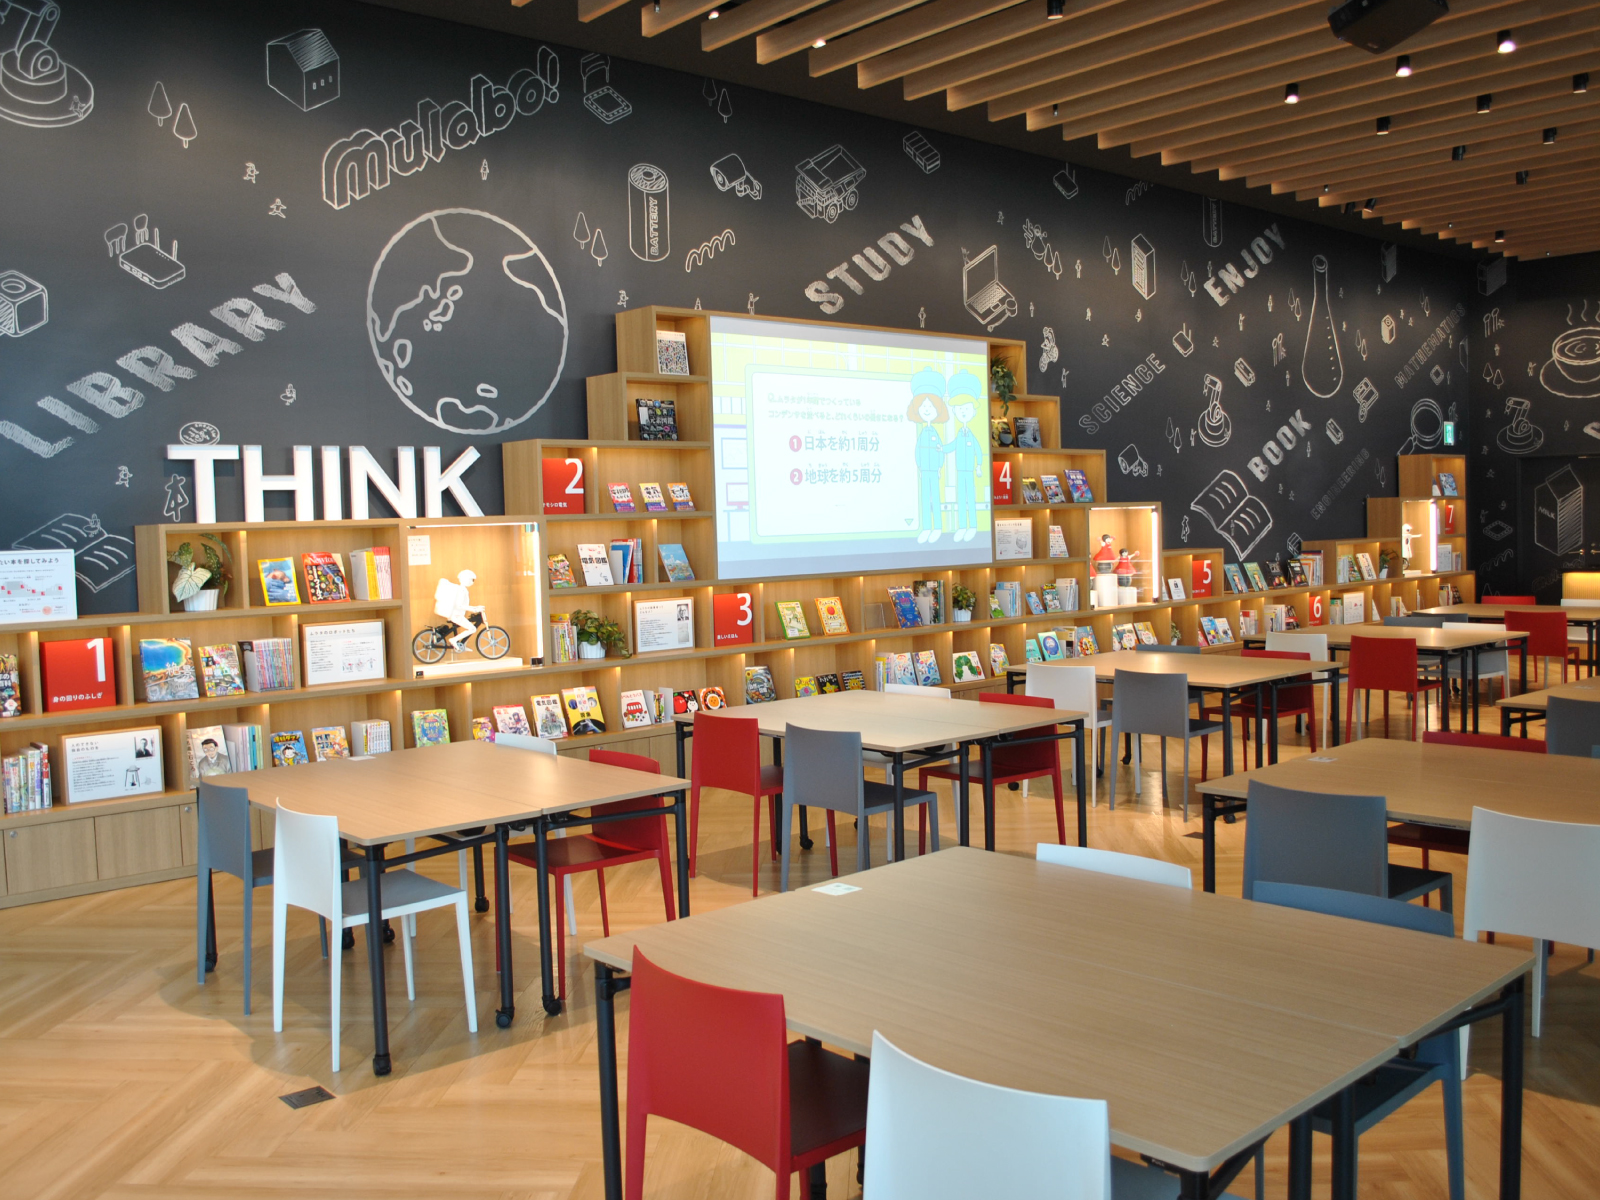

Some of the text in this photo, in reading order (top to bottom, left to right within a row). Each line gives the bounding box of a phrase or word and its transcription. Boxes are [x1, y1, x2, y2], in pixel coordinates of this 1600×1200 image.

[322, 45, 560, 210] mulabo!
[650, 196, 660, 256] BATTERY
[804, 215, 936, 316] STUDY
[1203, 223, 1286, 306] ENJOY
[0, 273, 316, 458] LIBRARY
[1394, 302, 1466, 390] MATHEMATICS
[1079, 353, 1166, 434] SCIENCE
[805, 436, 880, 452] 日本を約1周分
[1247, 409, 1312, 482] BOOK
[167, 444, 486, 524] THINK
[565, 458, 584, 494] 2
[805, 468, 882, 484] 地球を約5周分
[999, 462, 1012, 490] 4
[1311, 447, 1370, 520] ENGINEERING
[1448, 505, 1454, 524] 7
[1538, 506, 1556, 520] MILK
[1202, 560, 1212, 584] 5
[736, 592, 753, 626] 3
[1313, 595, 1322, 618] 6
[86, 638, 106, 682] 1
[52, 692, 104, 704] 身の回りのふしぎ
